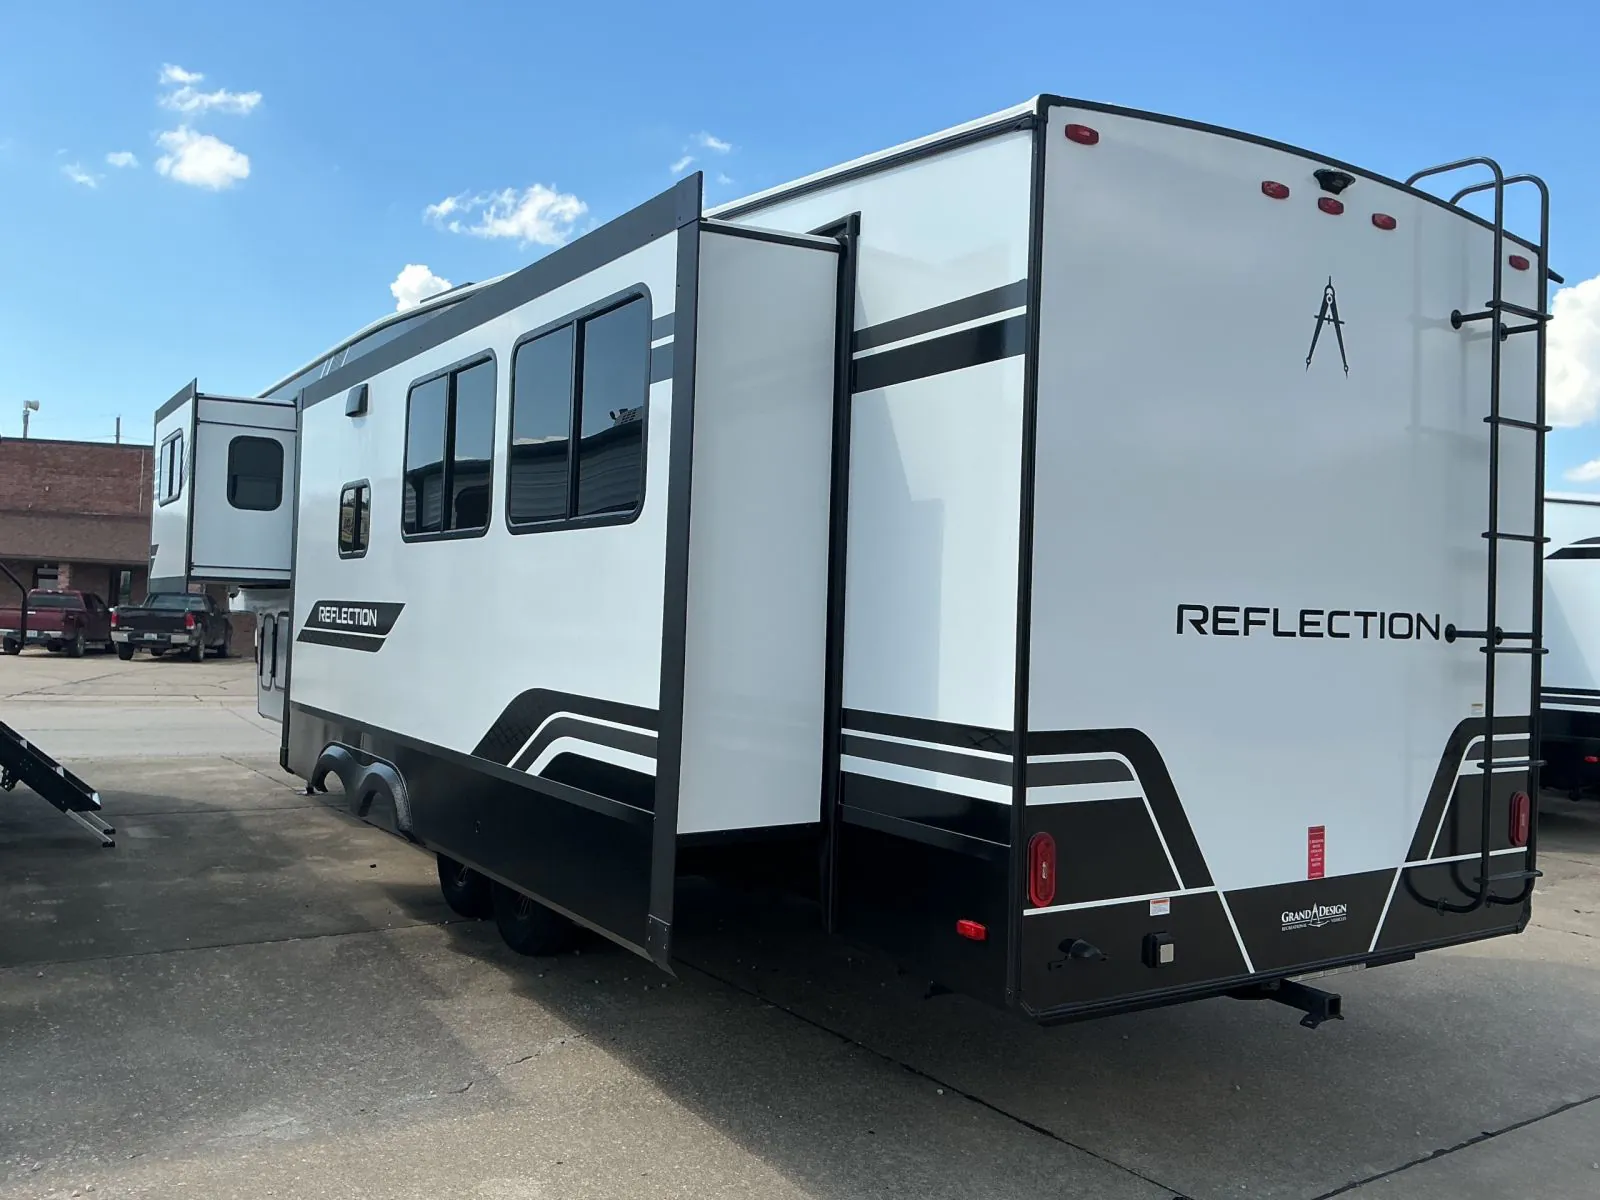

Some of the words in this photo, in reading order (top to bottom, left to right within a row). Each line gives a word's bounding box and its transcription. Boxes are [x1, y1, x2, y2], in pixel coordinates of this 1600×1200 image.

[318, 606, 378, 627] REFLECTION
[1177, 604, 1440, 640] REFLECTION
[1281, 909, 1311, 923] GRAND
[1319, 903, 1347, 917] DESIGN
